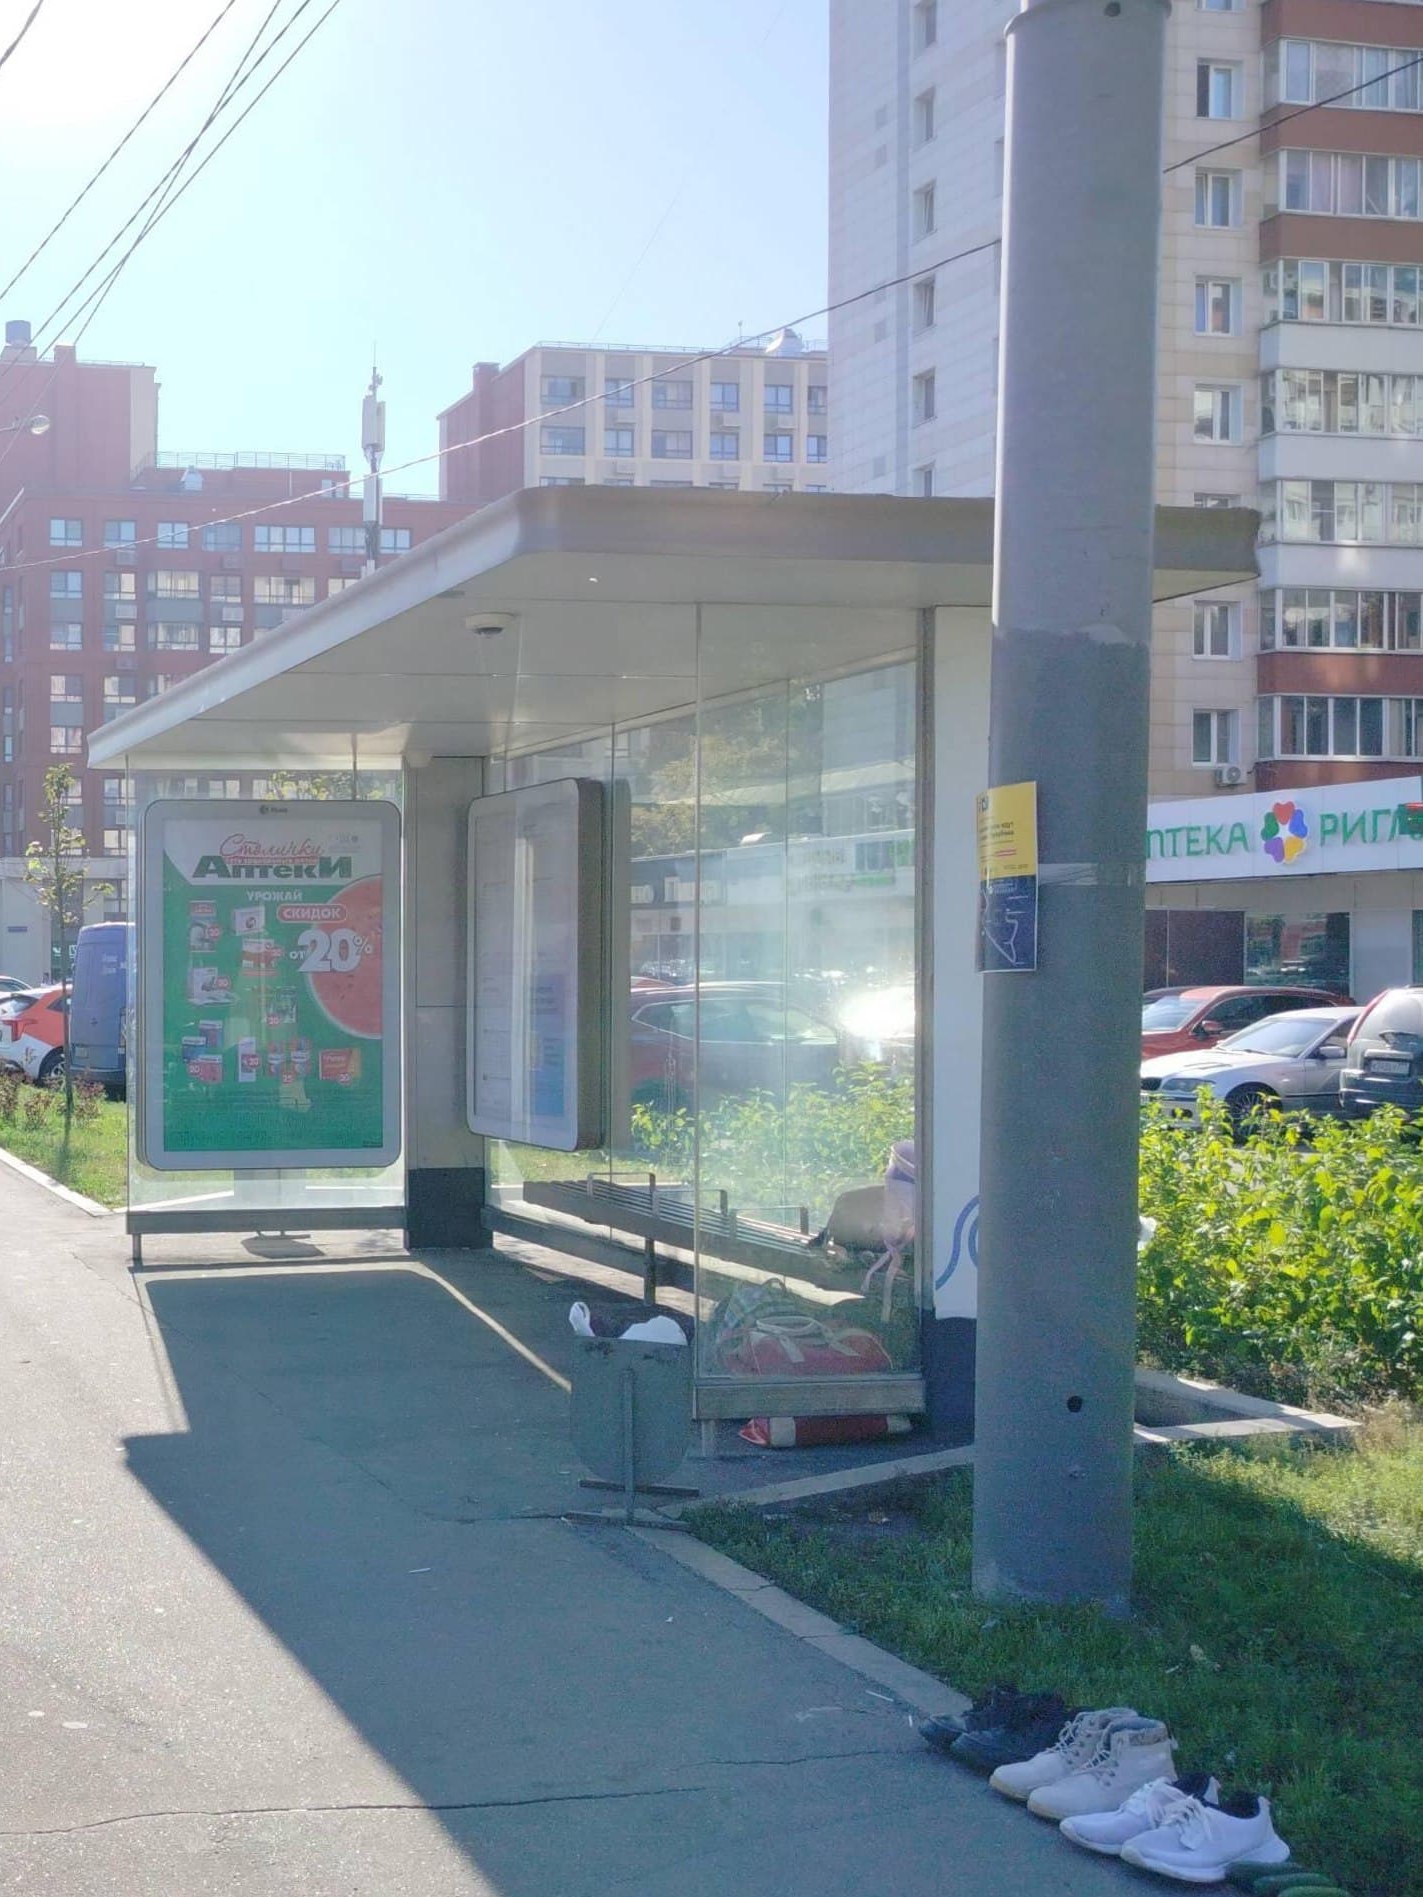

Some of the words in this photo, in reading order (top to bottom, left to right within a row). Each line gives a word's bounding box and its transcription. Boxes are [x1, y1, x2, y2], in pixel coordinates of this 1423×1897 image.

[219, 833, 325, 857] Столички
[1147, 823, 1249, 859] ПТЕКА
[246, 890, 302, 901] УРОЖАЙ
[282, 907, 341, 920] СКИДОК
